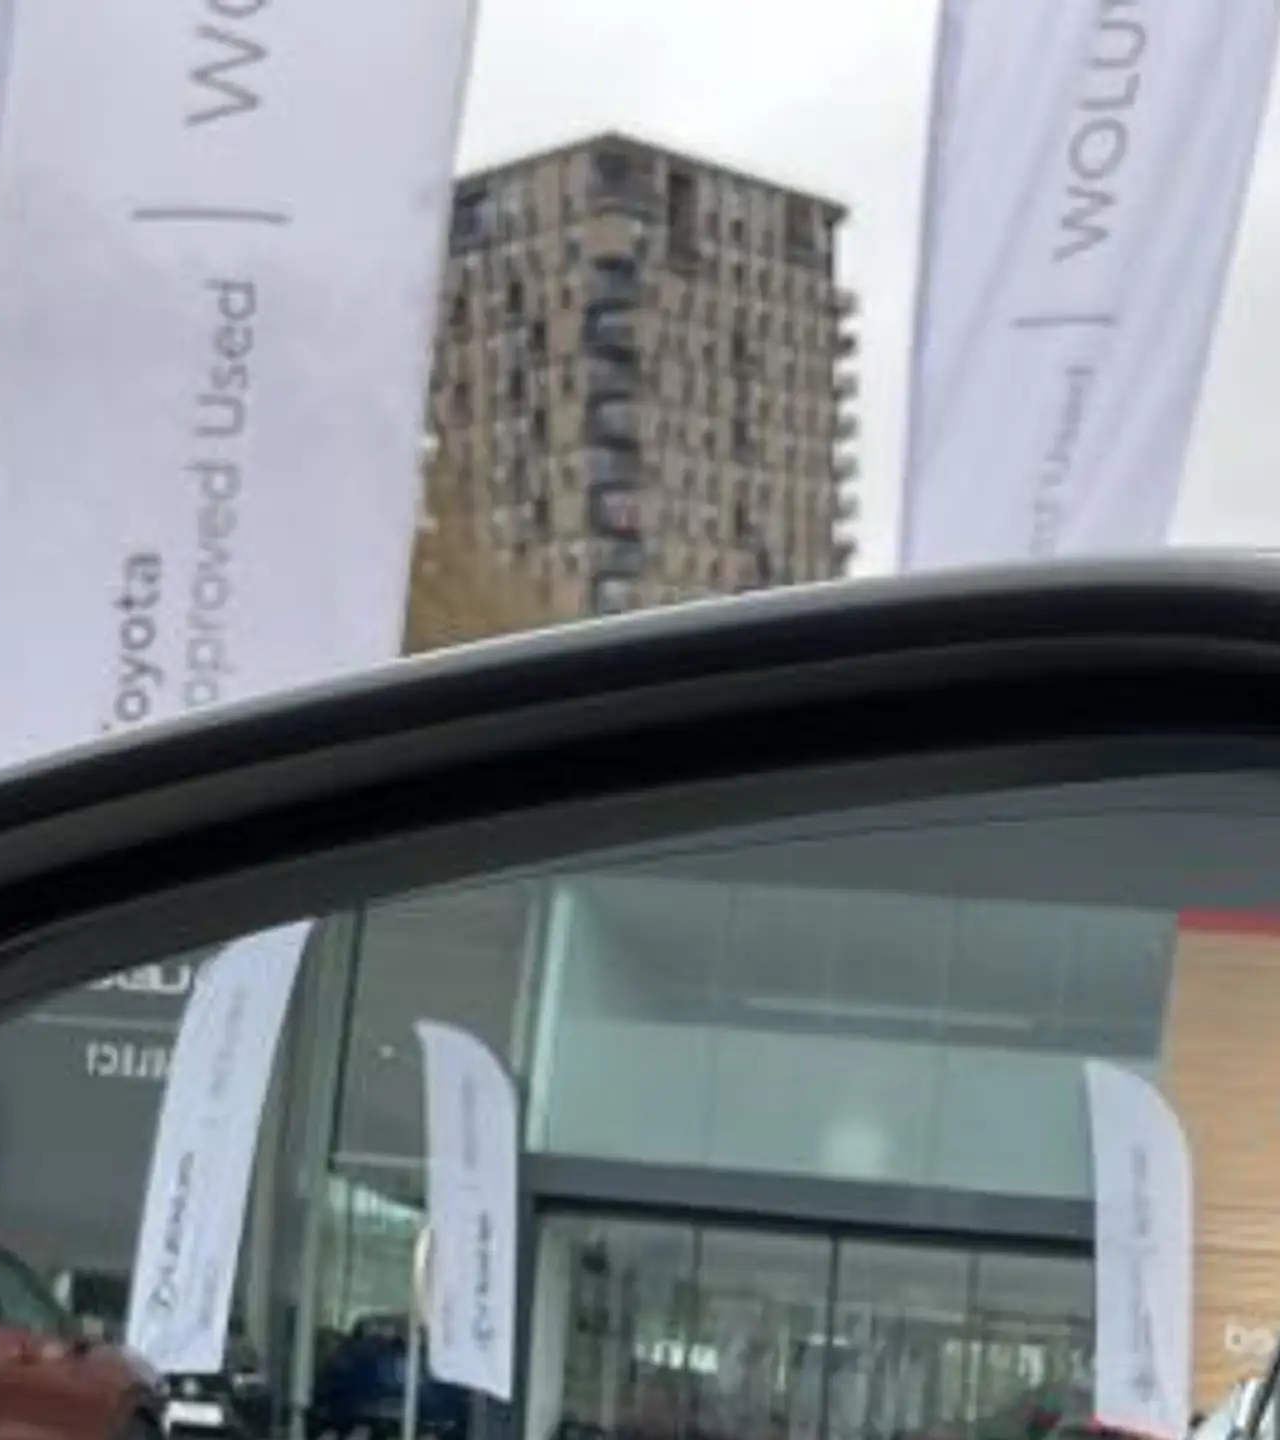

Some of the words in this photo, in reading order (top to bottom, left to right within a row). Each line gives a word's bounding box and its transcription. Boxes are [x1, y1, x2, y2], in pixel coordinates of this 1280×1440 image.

[1053, 0, 1147, 263] WOLU
[196, 278, 257, 438] Used
[102, 552, 166, 732] oyota
[180, 457, 243, 708] pproved
